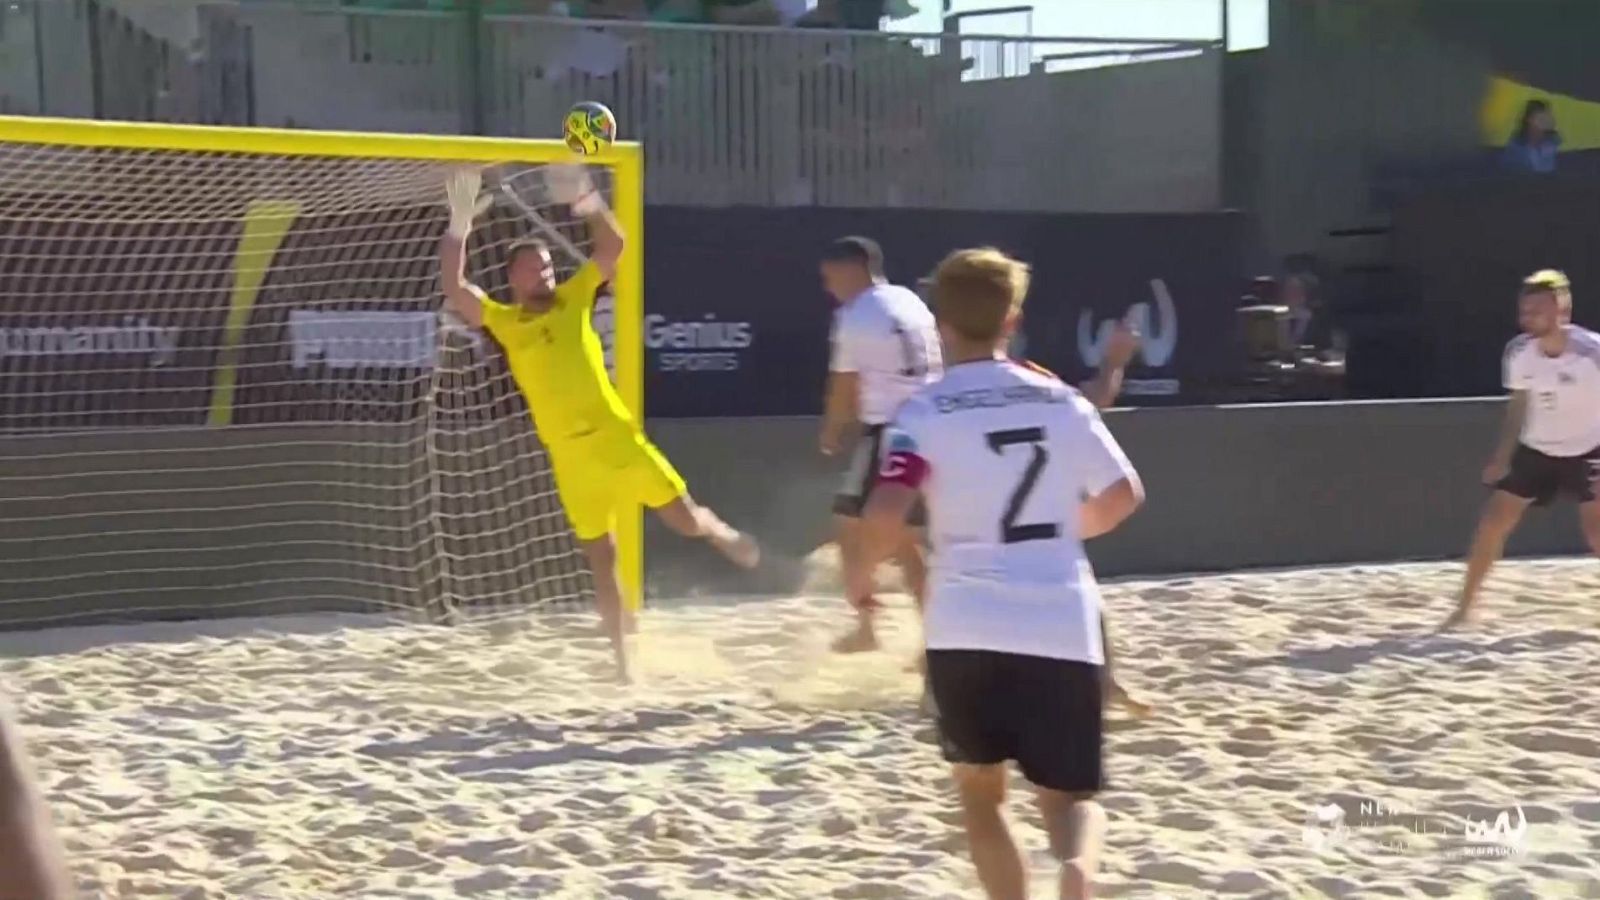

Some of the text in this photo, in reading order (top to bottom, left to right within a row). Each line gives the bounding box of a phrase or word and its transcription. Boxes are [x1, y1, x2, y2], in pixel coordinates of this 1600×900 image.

[644, 313, 752, 348] Genius
[659, 351, 738, 372] SPORTS
[984, 427, 1058, 543] 2
